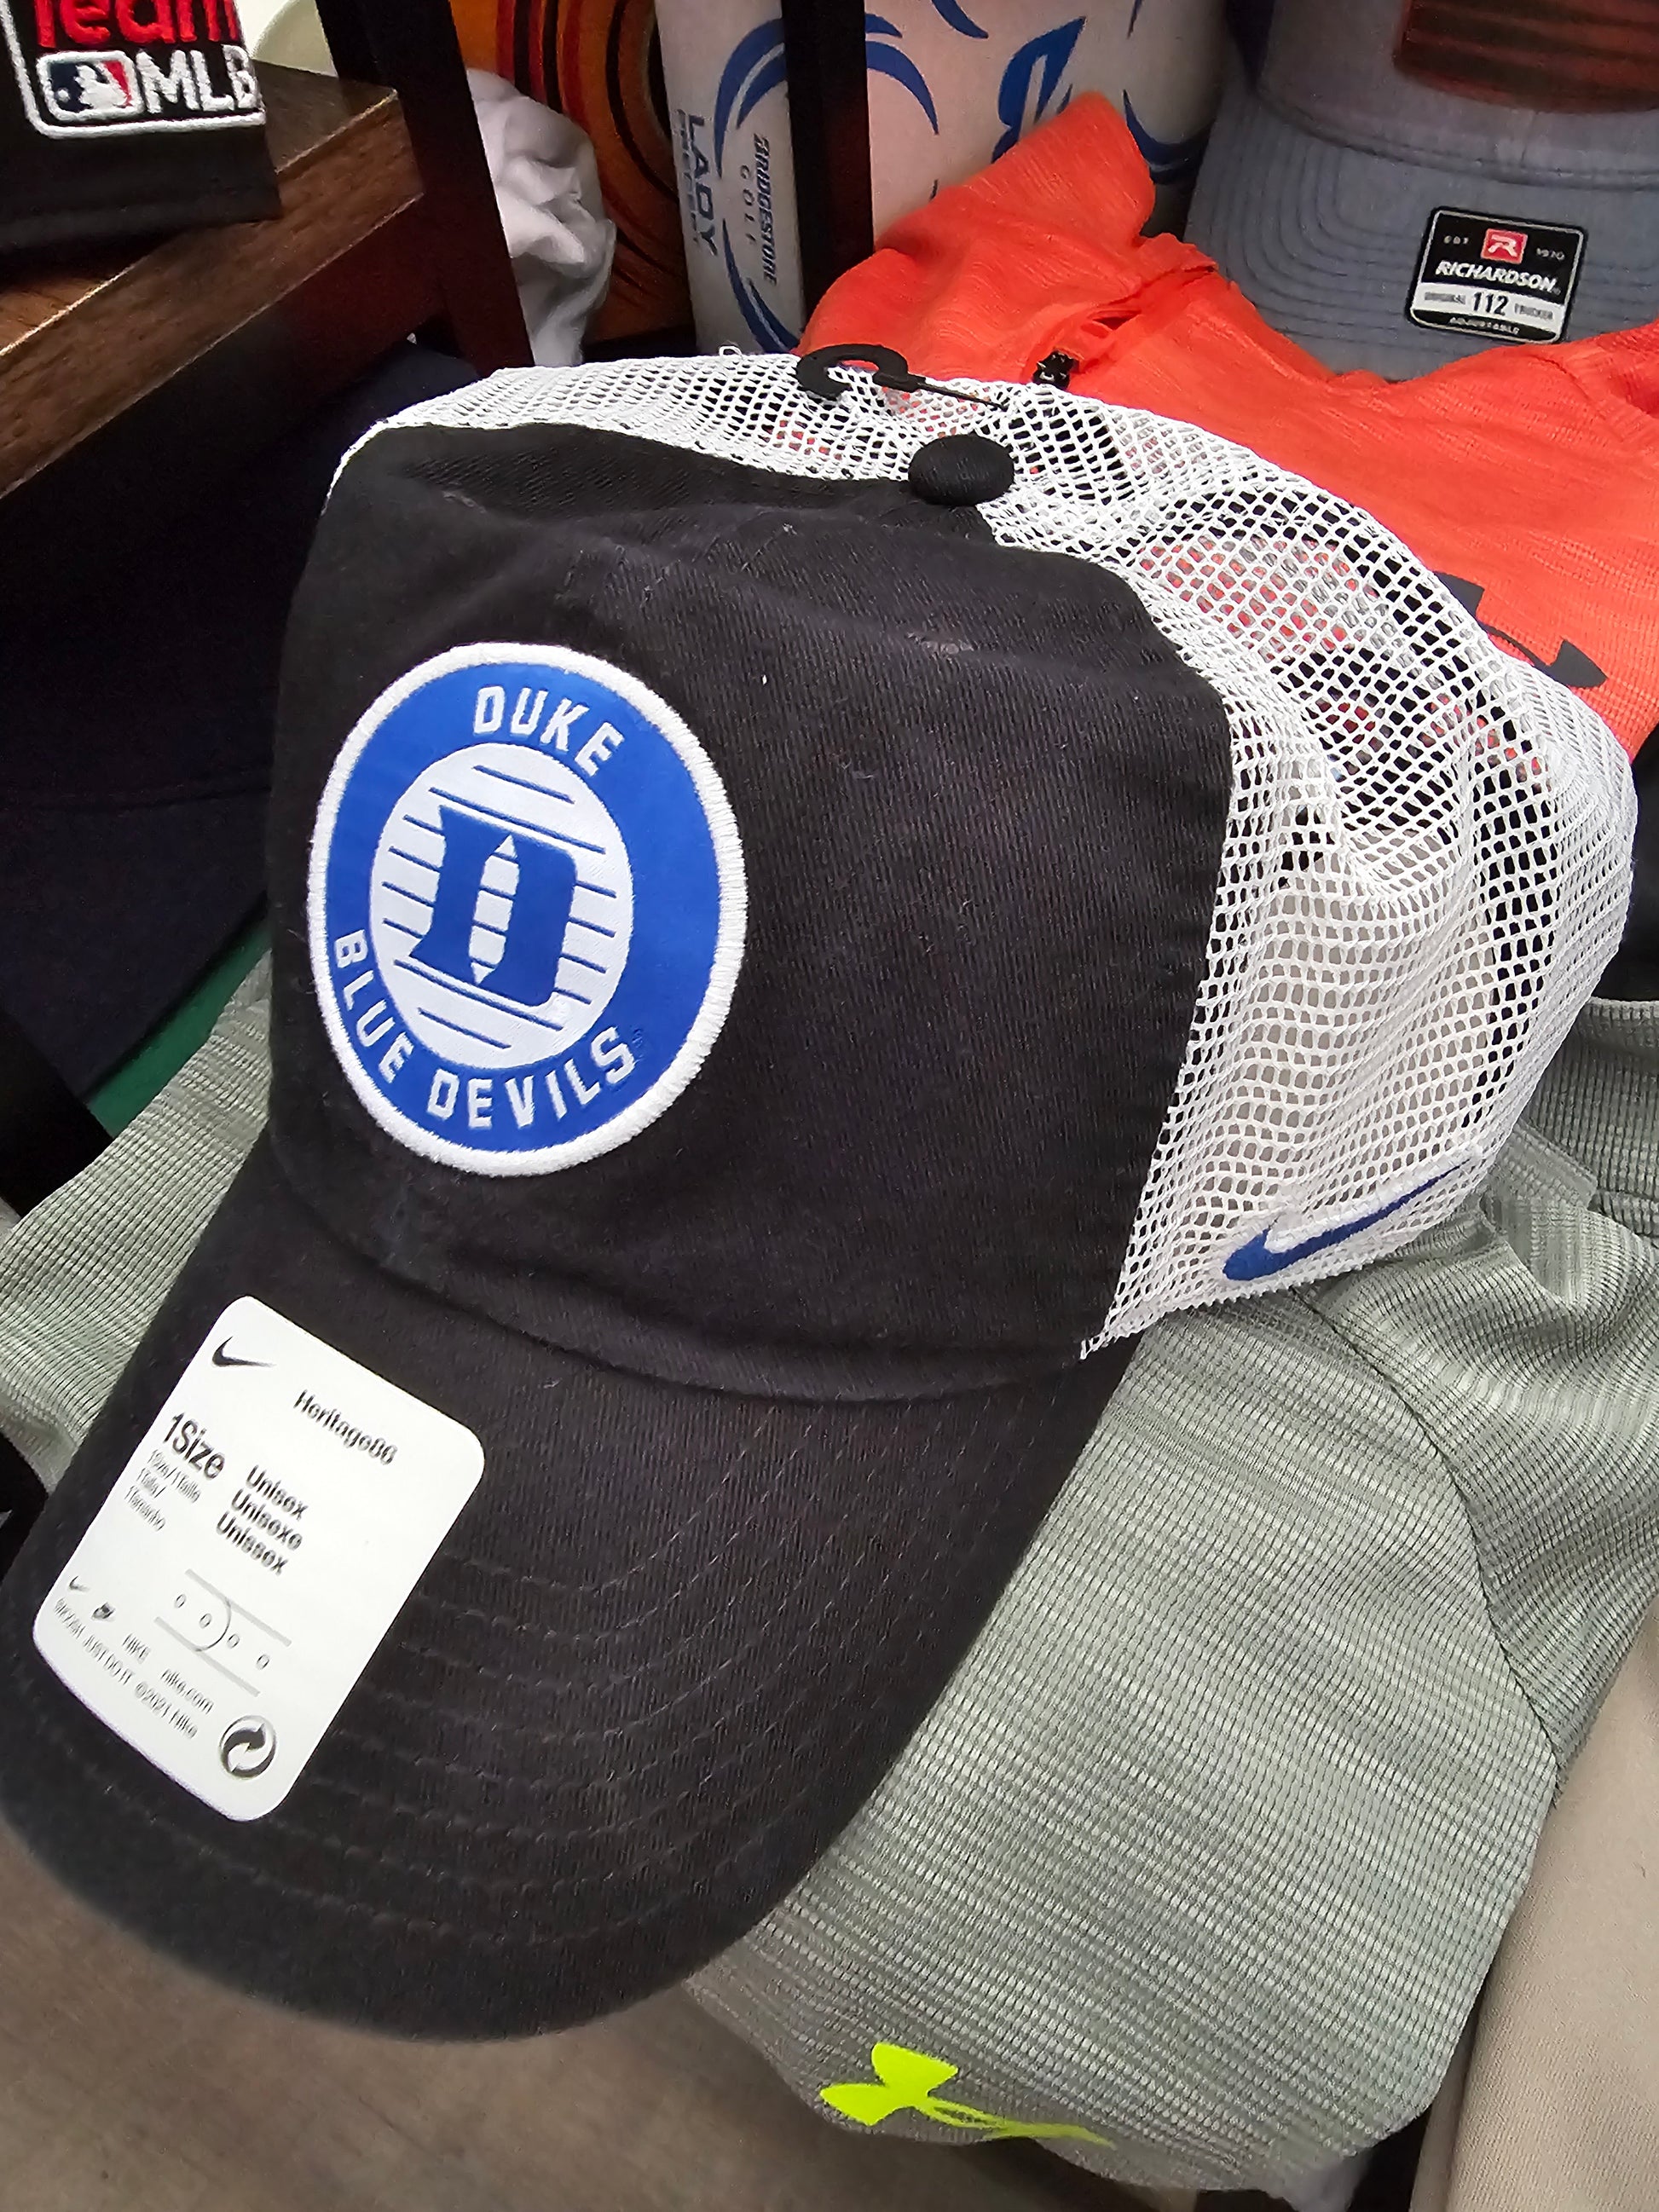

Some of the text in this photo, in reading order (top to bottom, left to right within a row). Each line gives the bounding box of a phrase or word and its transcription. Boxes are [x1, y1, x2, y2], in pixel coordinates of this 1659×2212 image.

[136, 44, 257, 113] MLB
[689, 114, 716, 256] LADY
[740, 165, 757, 245] GOLF
[754, 132, 777, 286] BRIDGESTONE
[1436, 259, 1558, 292] RICHARDSON
[1473, 291, 1509, 316] 112
[474, 685, 625, 777] DUKE
[334, 929, 637, 1130] BLUE DEVILS
[163, 1412, 226, 1481] 1Size
[246, 1464, 309, 1521] Unisex
